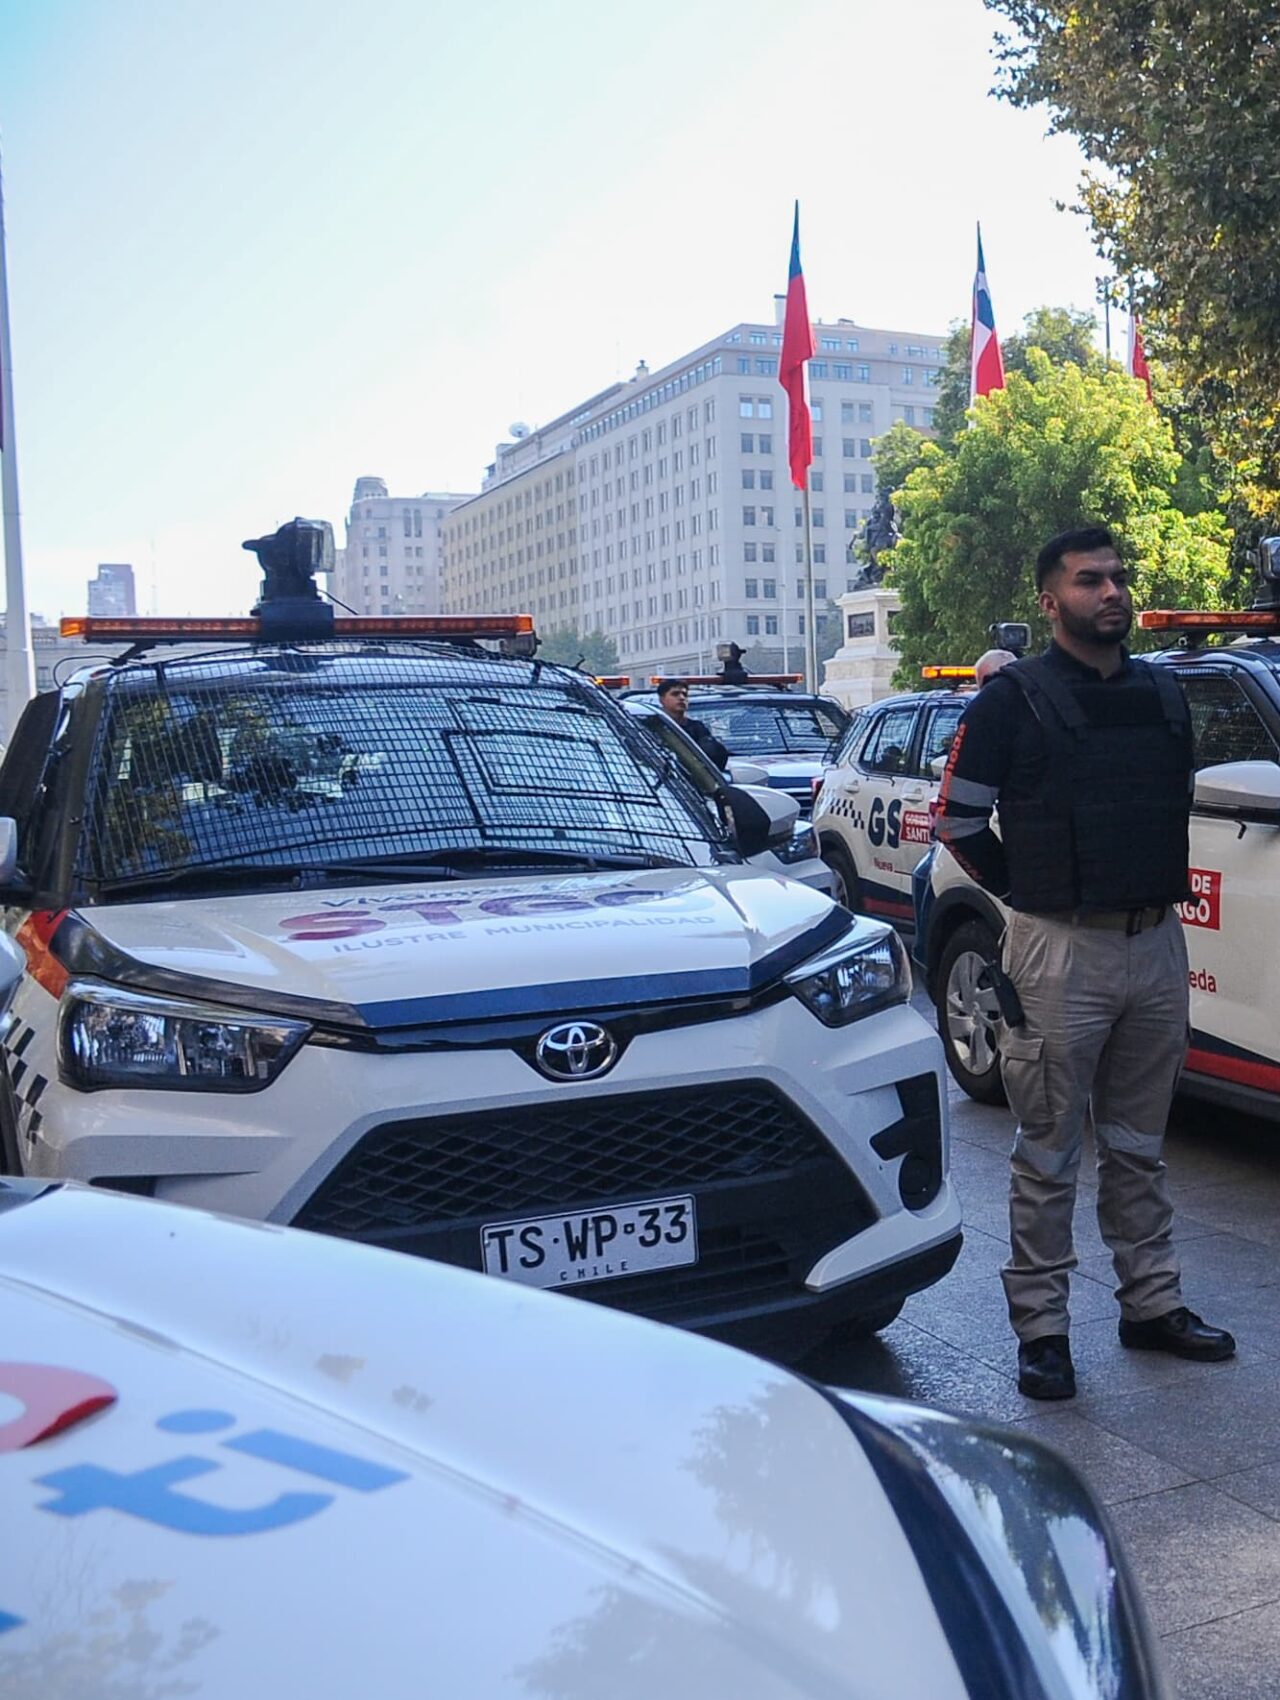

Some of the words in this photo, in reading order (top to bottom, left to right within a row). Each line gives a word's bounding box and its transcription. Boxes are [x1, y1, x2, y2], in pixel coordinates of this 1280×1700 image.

[868, 797, 902, 849] GS
[1191, 873, 1212, 895] DE
[484, 916, 716, 937] MUNICIPALIDAD
[332, 930, 467, 954] ILUSTRE
[560, 1261, 629, 1281] CHILE
